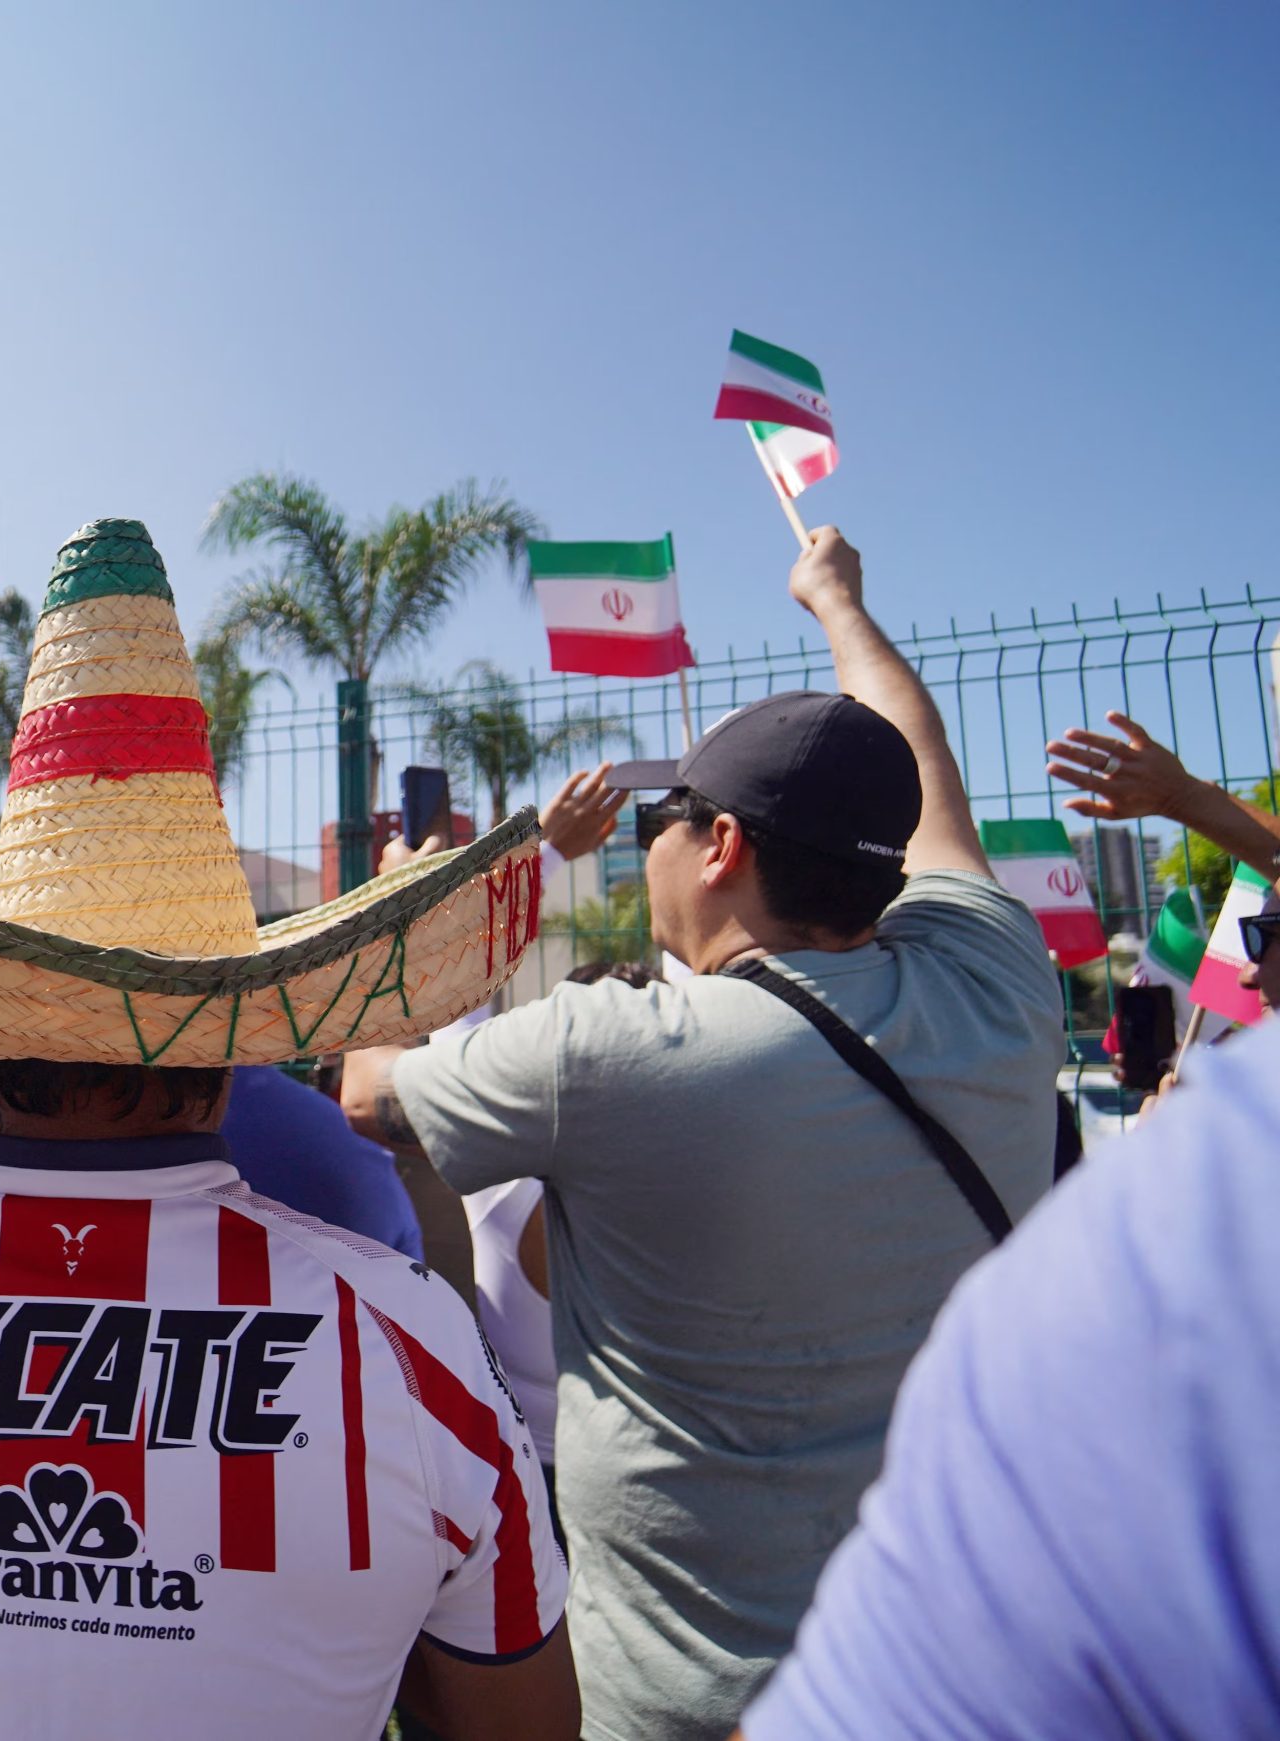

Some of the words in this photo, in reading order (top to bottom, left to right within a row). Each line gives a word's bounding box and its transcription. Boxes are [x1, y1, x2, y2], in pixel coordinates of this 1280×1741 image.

[857, 839, 894, 858] UNDER
[122, 928, 411, 1064] VIVA
[71, 1616, 110, 1635] cada
[113, 1622, 196, 1641] momento
